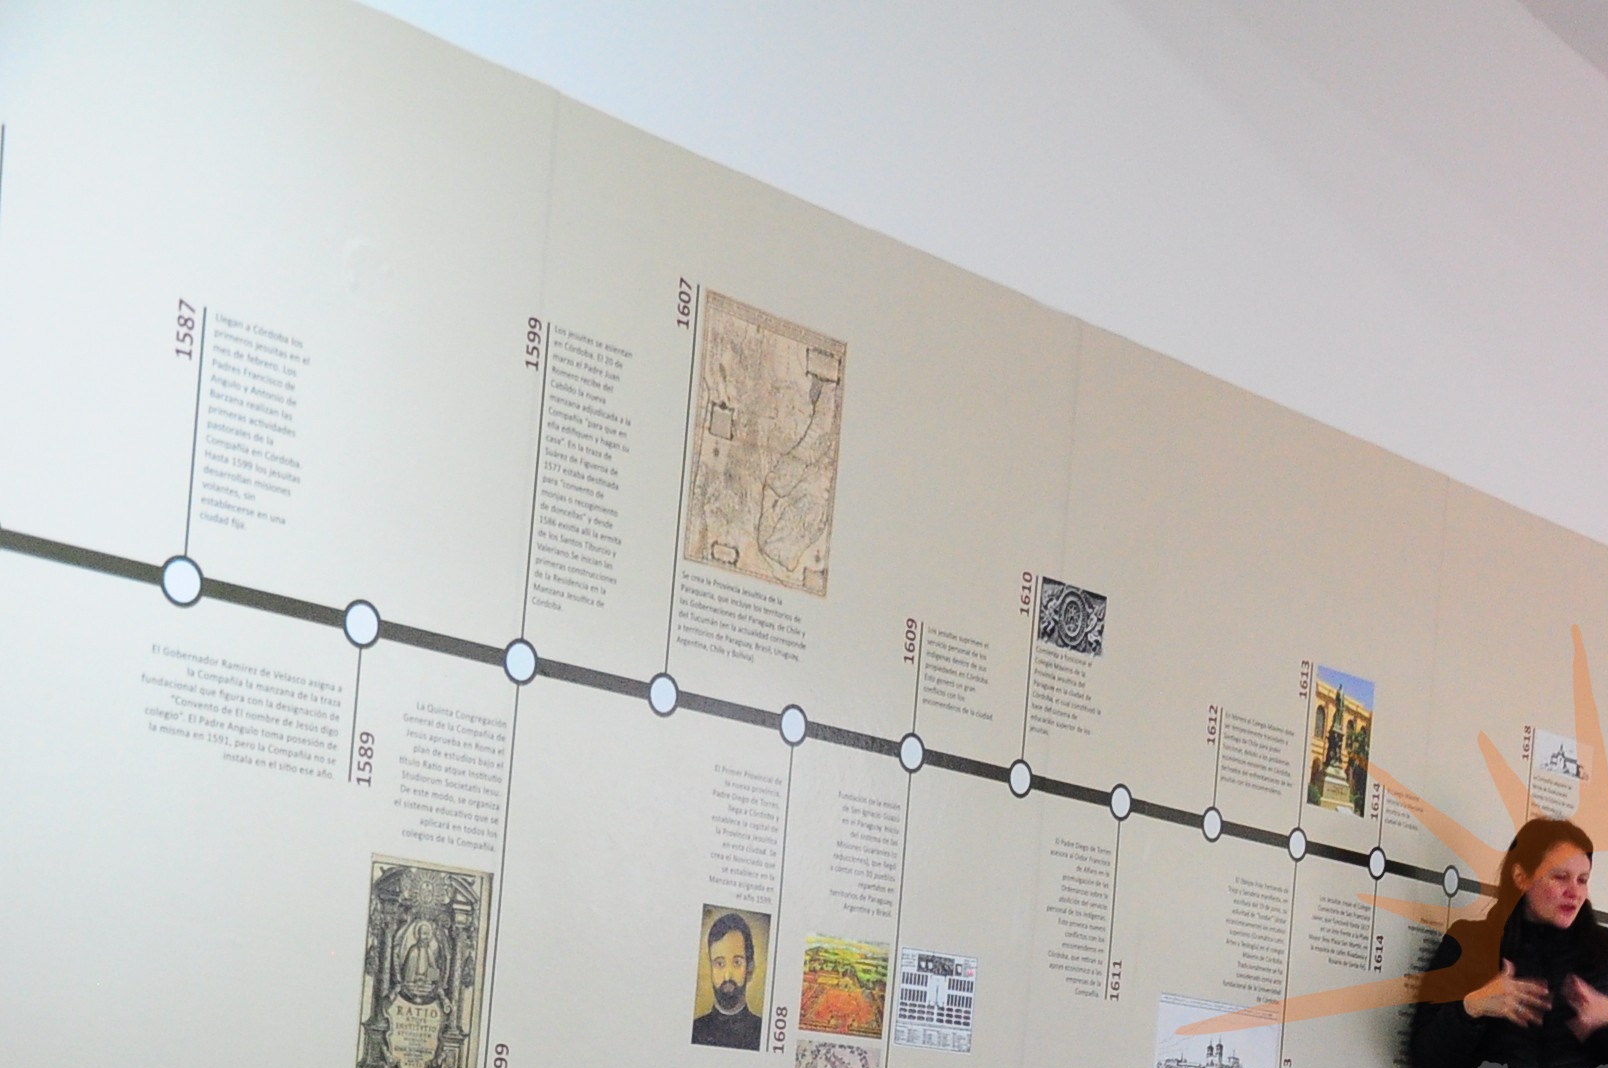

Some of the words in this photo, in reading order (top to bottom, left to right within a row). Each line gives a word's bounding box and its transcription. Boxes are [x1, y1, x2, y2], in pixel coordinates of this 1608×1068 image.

[676, 277, 693, 330] 1607
[175, 298, 196, 361] 1587
[213, 329, 253, 348] primeros
[254, 342, 287, 359] jesuitas
[288, 353, 300, 362] en
[301, 357, 311, 365] el
[215, 313, 243, 328] Llegan
[252, 324, 289, 344] Córdoba
[290, 336, 303, 349] los
[525, 317, 543, 372] 1599
[211, 357, 241, 375] Padres
[242, 367, 283, 388] Francisco
[284, 381, 295, 392] de
[212, 344, 231, 356] mes
[233, 349, 244, 360] de
[282, 364, 296, 377] Los
[210, 373, 241, 390] Angulo
[250, 386, 284, 403] Antonio
[285, 396, 297, 407] de
[207, 405, 246, 422] primeras
[248, 417, 296, 437] actividades
[245, 401, 279, 416] realizan
[280, 409, 293, 421] las
[206, 420, 251, 439] pastorales
[252, 432, 264, 443] de
[266, 435, 274, 446] la
[204, 449, 229, 464] Hasta
[232, 456, 253, 470] 1599
[254, 463, 267, 475] los
[268, 468, 300, 484] jesuitas
[250, 448, 263, 457] en
[203, 465, 252, 485] desarrollan
[253, 480, 291, 496] misiones
[243, 492, 256, 501] sin
[199, 512, 229, 525] ciudad
[200, 496, 254, 516] establecerse
[256, 511, 268, 519] en
[269, 514, 286, 525] una
[1020, 571, 1034, 617] 1610
[904, 618, 918, 665] 1609
[151, 643, 160, 654] El
[162, 646, 218, 666] Gobernador
[259, 667, 271, 678] de
[273, 670, 306, 685] Velasco
[308, 679, 335, 691] asigna
[1299, 660, 1310, 699] 1613
[141, 673, 197, 692] fundacional
[198, 687, 216, 696] que
[218, 688, 245, 702] figura
[246, 696, 263, 706] con
[265, 698, 274, 709] la
[275, 701, 327, 718] designación
[329, 712, 340, 722] de
[186, 667, 195, 677] la
[244, 678, 253, 690] la
[255, 683, 295, 698] manzana
[296, 690, 308, 700] de
[310, 692, 318, 703] la
[320, 695, 341, 708] traza
[170, 694, 219, 712] "Convento
[221, 705, 233, 715] de
[234, 707, 243, 718] El
[245, 711, 280, 725] nombre
[282, 717, 293, 727] de
[295, 720, 318, 732] Jesús
[320, 725, 339, 737] digo
[187, 713, 197, 723] El
[198, 715, 225, 729] Padre
[226, 721, 259, 736] Angulo
[260, 728, 284, 741] toma
[286, 734, 325, 748] posesión
[326, 741, 337, 751] de
[1207, 705, 1218, 745] 1612
[148, 721, 157, 732] la
[159, 725, 190, 738] misma
[192, 731, 204, 740] en
[234, 739, 255, 750] pero
[257, 741, 266, 752] la
[313, 754, 325, 763] no
[326, 757, 336, 765] se
[356, 731, 375, 788] 1589
[1522, 725, 1531, 761] 1618
[222, 752, 253, 765] instala
[254, 758, 266, 766] en
[268, 760, 277, 768] el
[298, 767, 314, 776] ese
[316, 769, 335, 779] año.
[1371, 783, 1381, 820] 1614
[1374, 935, 1384, 974] 1614
[1110, 960, 1122, 1002] 1611
[396, 1005, 438, 1018] RATIO
[773, 1006, 788, 1054] 1608
